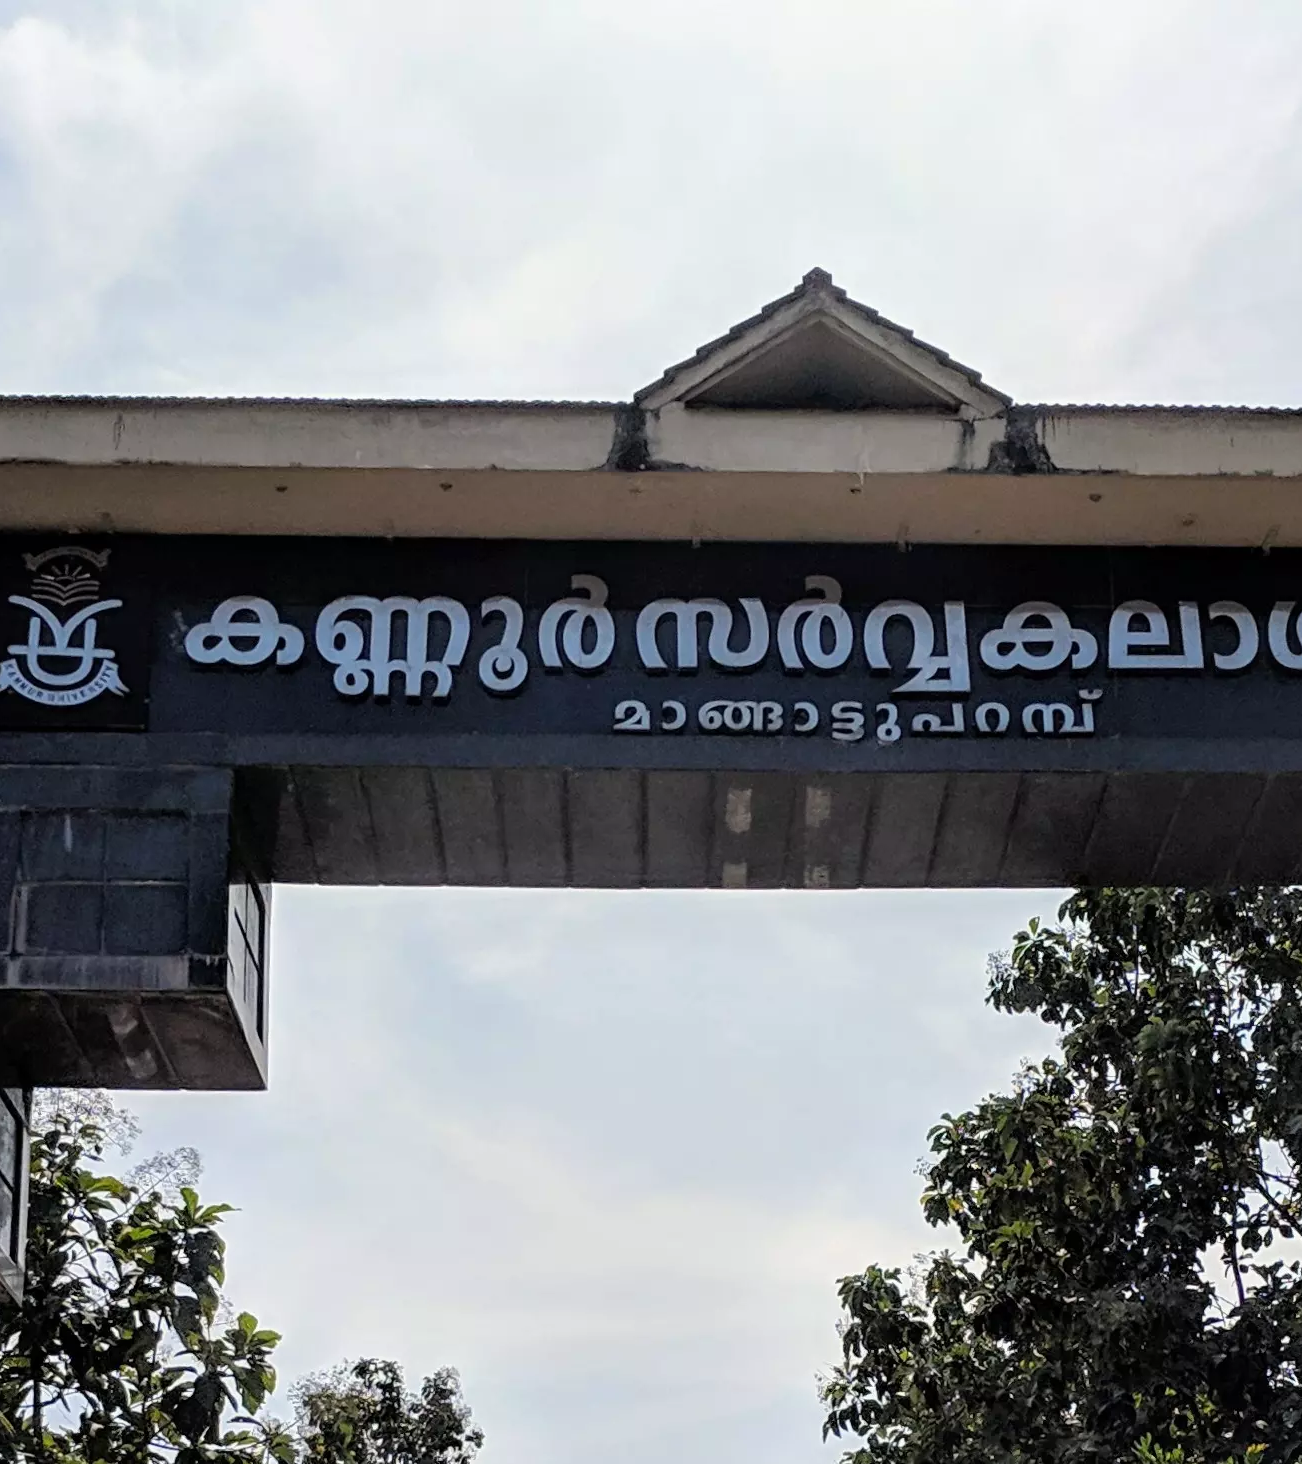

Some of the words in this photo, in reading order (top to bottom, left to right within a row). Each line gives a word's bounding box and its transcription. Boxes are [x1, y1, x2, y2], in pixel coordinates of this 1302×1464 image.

[183, 574, 617, 698] കണ്ണൂർ
[3, 663, 44, 697] KANNUR
[613, 687, 1104, 744] മാങ്ങാട്ടുപറമ്പ്
